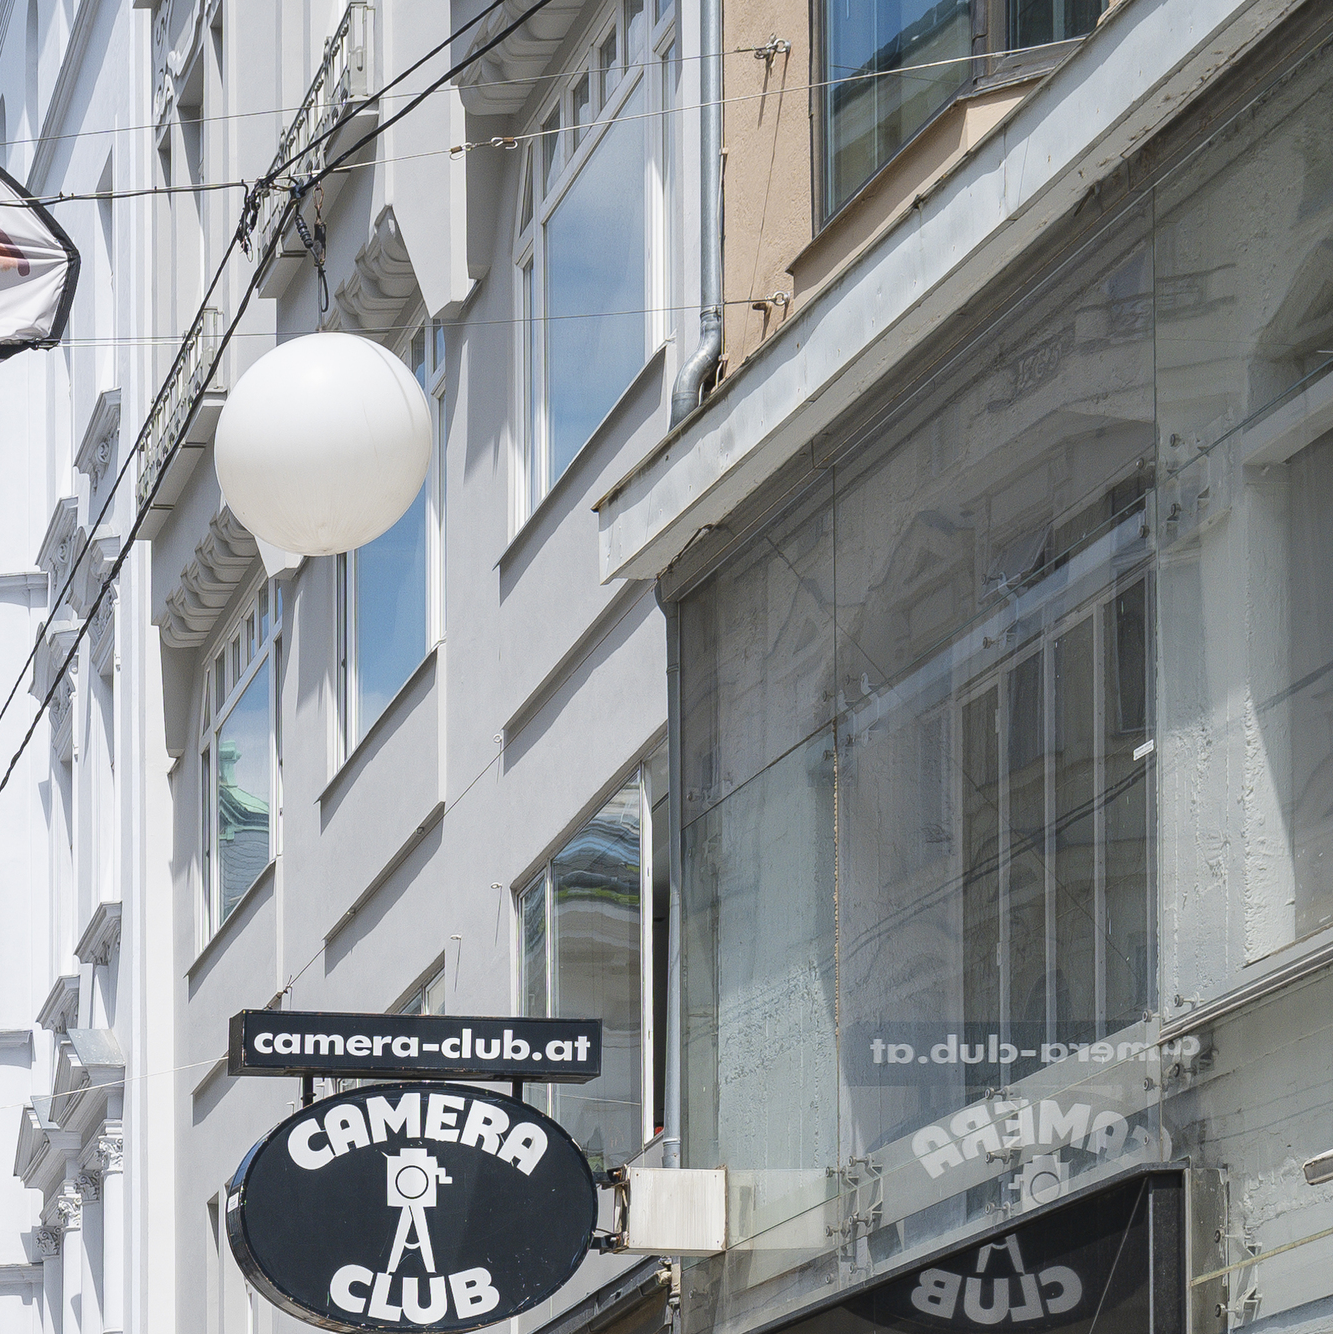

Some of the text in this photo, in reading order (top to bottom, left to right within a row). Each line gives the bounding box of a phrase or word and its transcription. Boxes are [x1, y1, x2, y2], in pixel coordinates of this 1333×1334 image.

[253, 1028, 591, 1062] camera-club.at
[287, 1092, 549, 1176] CAMERA
[329, 1264, 500, 1325] CLUB
